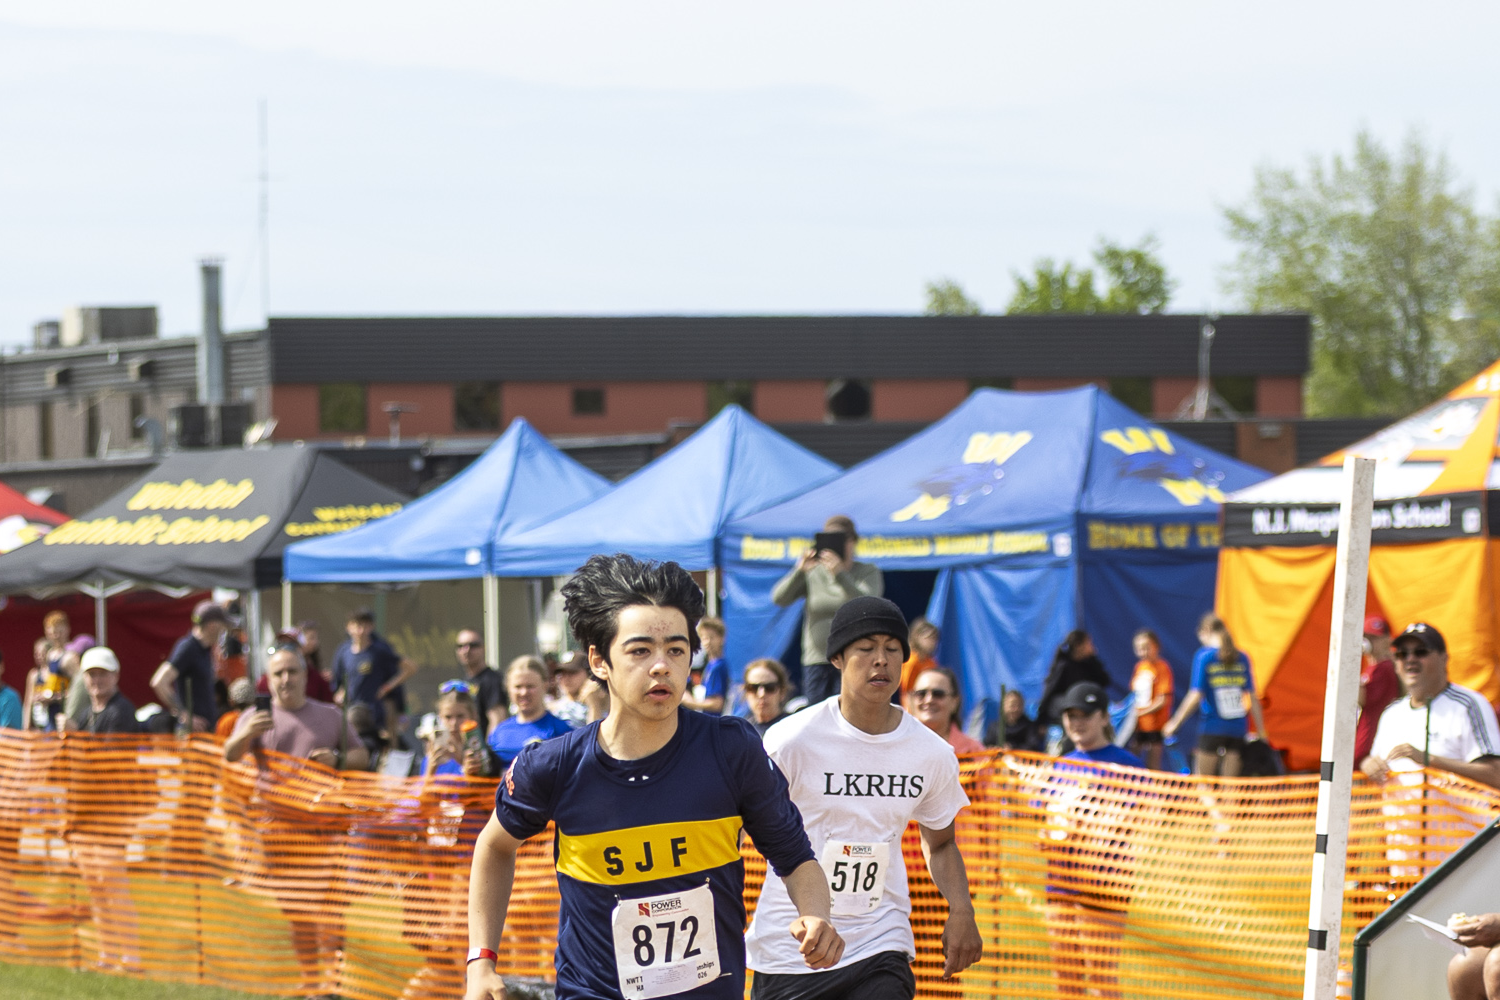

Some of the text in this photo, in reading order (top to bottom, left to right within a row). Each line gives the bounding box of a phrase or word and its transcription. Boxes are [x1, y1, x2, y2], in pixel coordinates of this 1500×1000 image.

[1392, 499, 1452, 530] School
[823, 772, 924, 799] LKRHS
[831, 861, 879, 893] 518
[651, 899, 682, 910] POWER
[632, 915, 702, 967] 872
